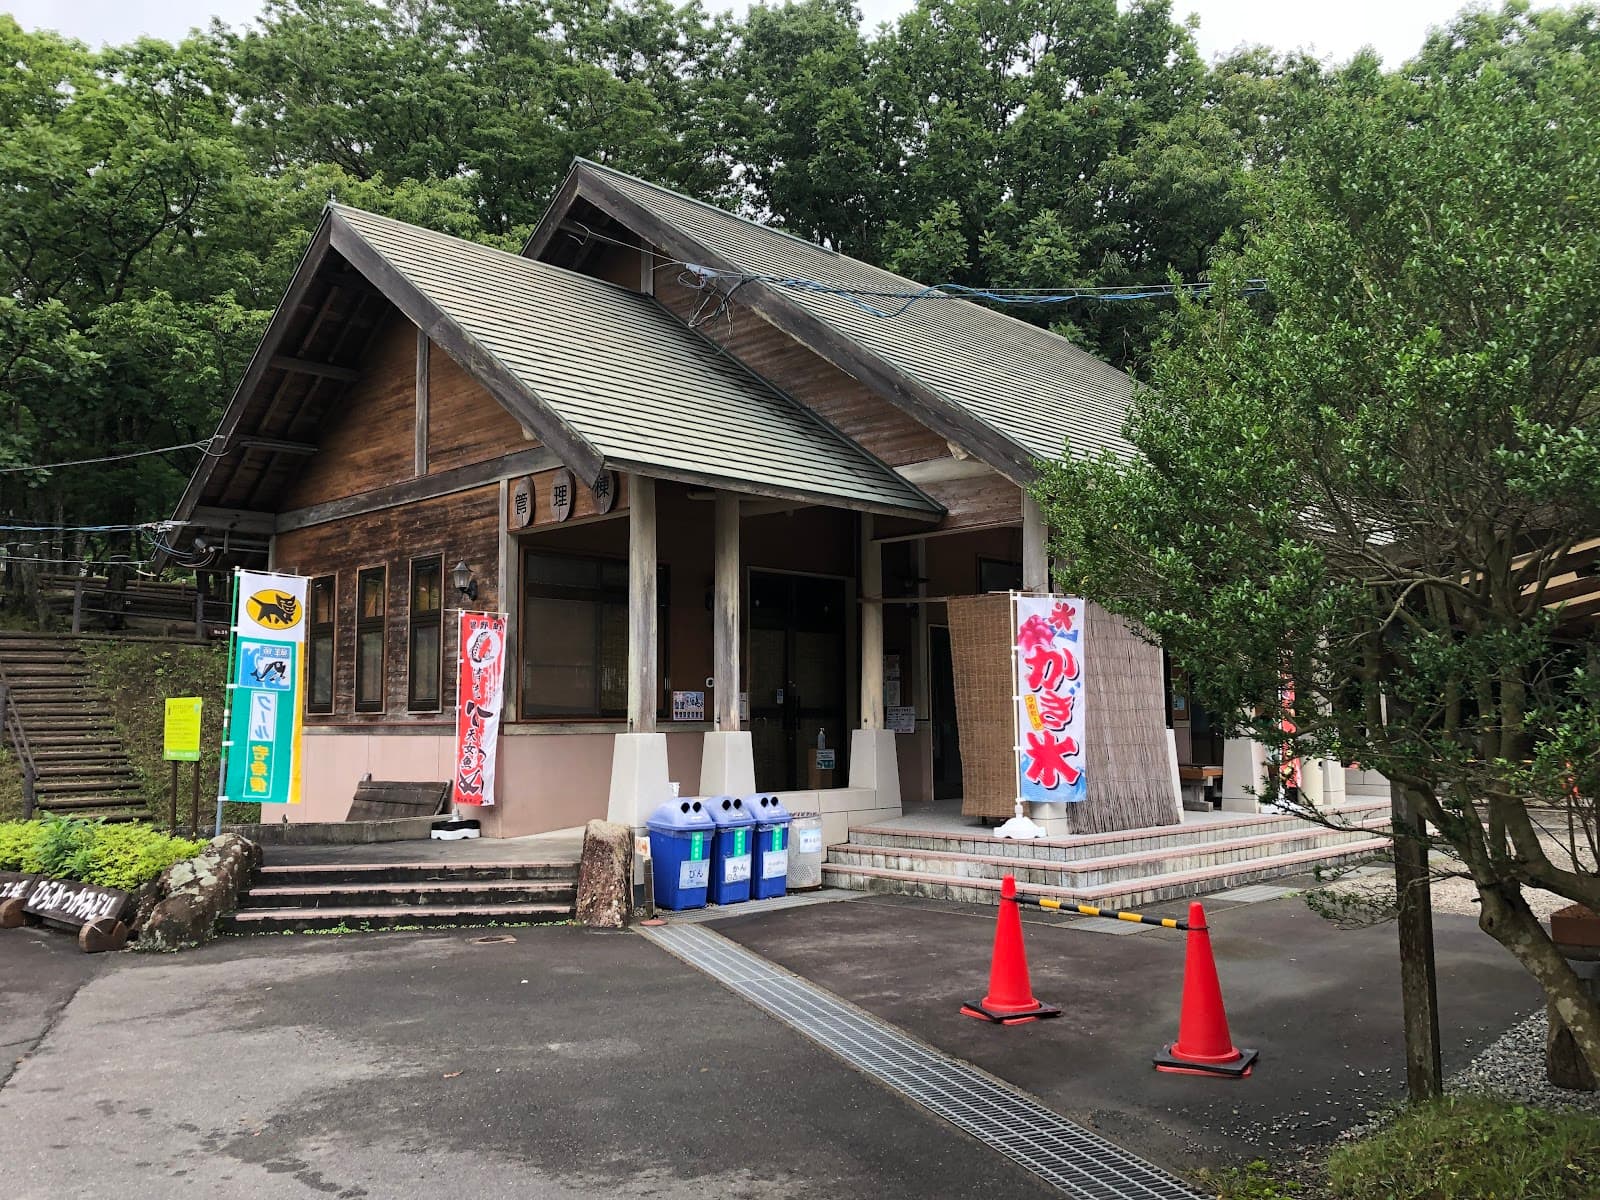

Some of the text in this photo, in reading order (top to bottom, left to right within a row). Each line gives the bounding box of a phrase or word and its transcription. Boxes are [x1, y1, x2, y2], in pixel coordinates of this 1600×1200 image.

[515, 476, 610, 515] 管理棟
[1024, 645, 1080, 790] かき氷
[460, 727, 477, 769] 天女魚
